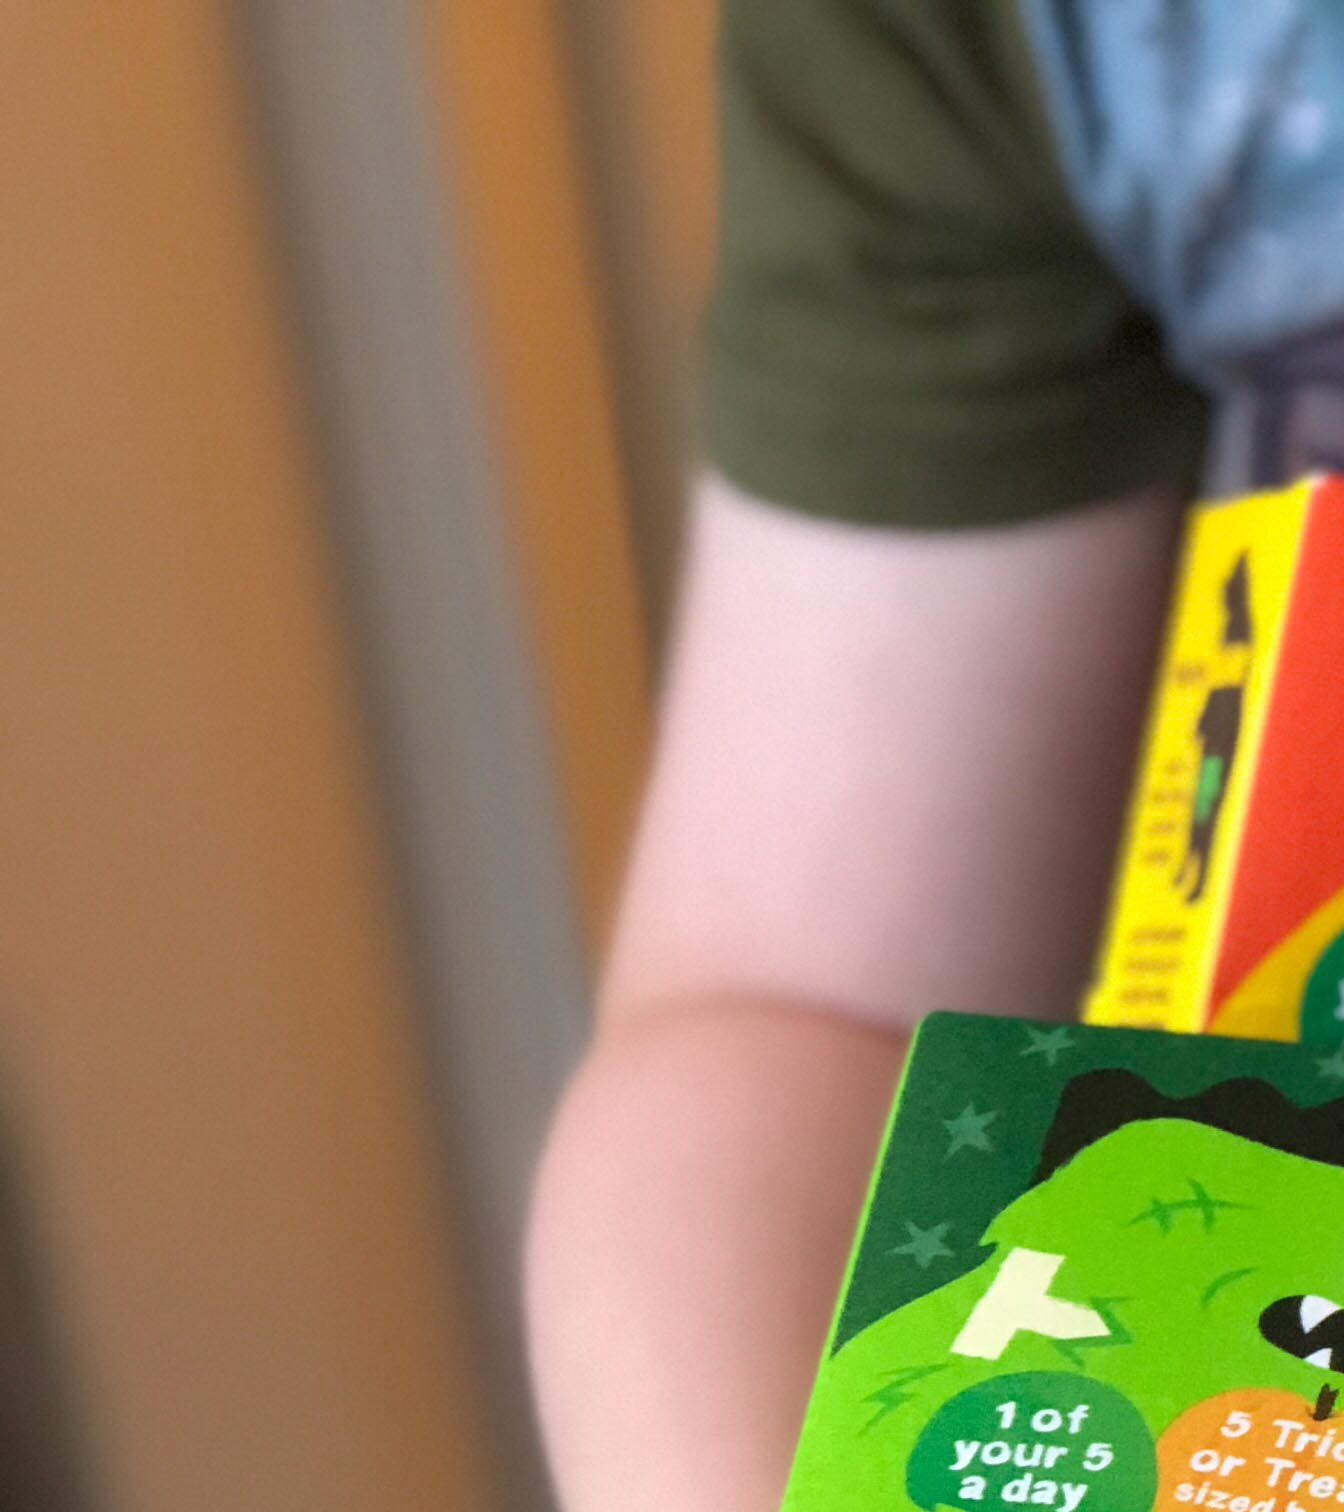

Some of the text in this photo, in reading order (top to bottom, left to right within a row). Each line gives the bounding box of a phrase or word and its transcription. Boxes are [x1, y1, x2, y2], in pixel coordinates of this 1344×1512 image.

[995, 1401, 1090, 1435] 1 of
[1220, 1410, 1252, 1440] 5
[948, 1438, 1114, 1472] your 5
[1188, 1447, 1246, 1474] or
[957, 1474, 986, 1501] a
